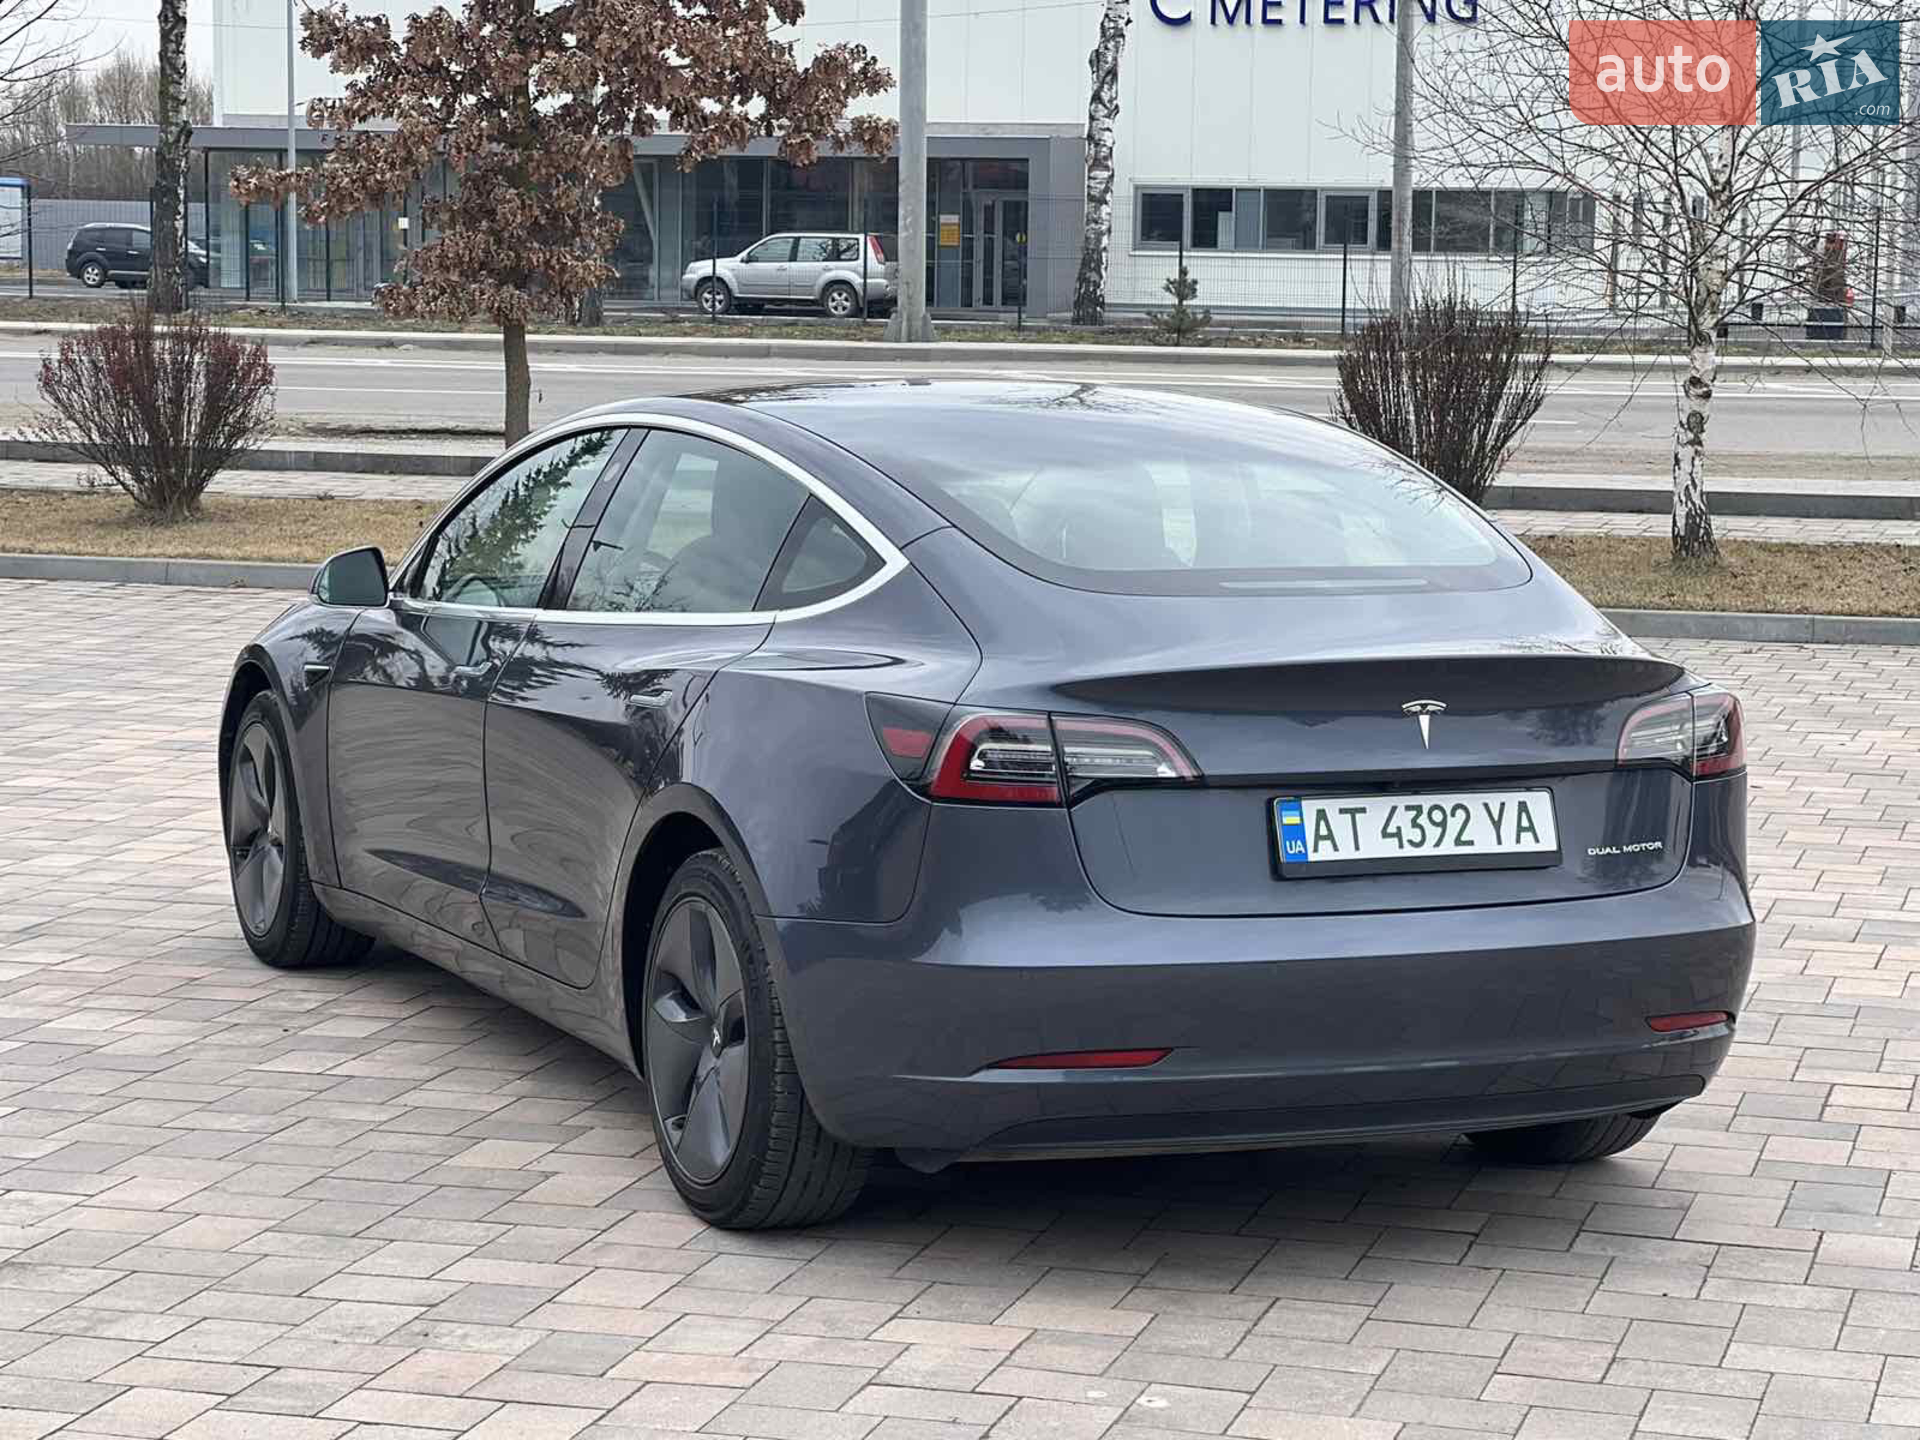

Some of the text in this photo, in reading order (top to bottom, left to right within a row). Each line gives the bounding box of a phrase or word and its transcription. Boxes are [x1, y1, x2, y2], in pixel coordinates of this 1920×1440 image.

[1312, 800, 1540, 853] AT 4392 YA
[1285, 840, 1306, 854] UA
[1587, 841, 1663, 856] DUAL MOTOR
